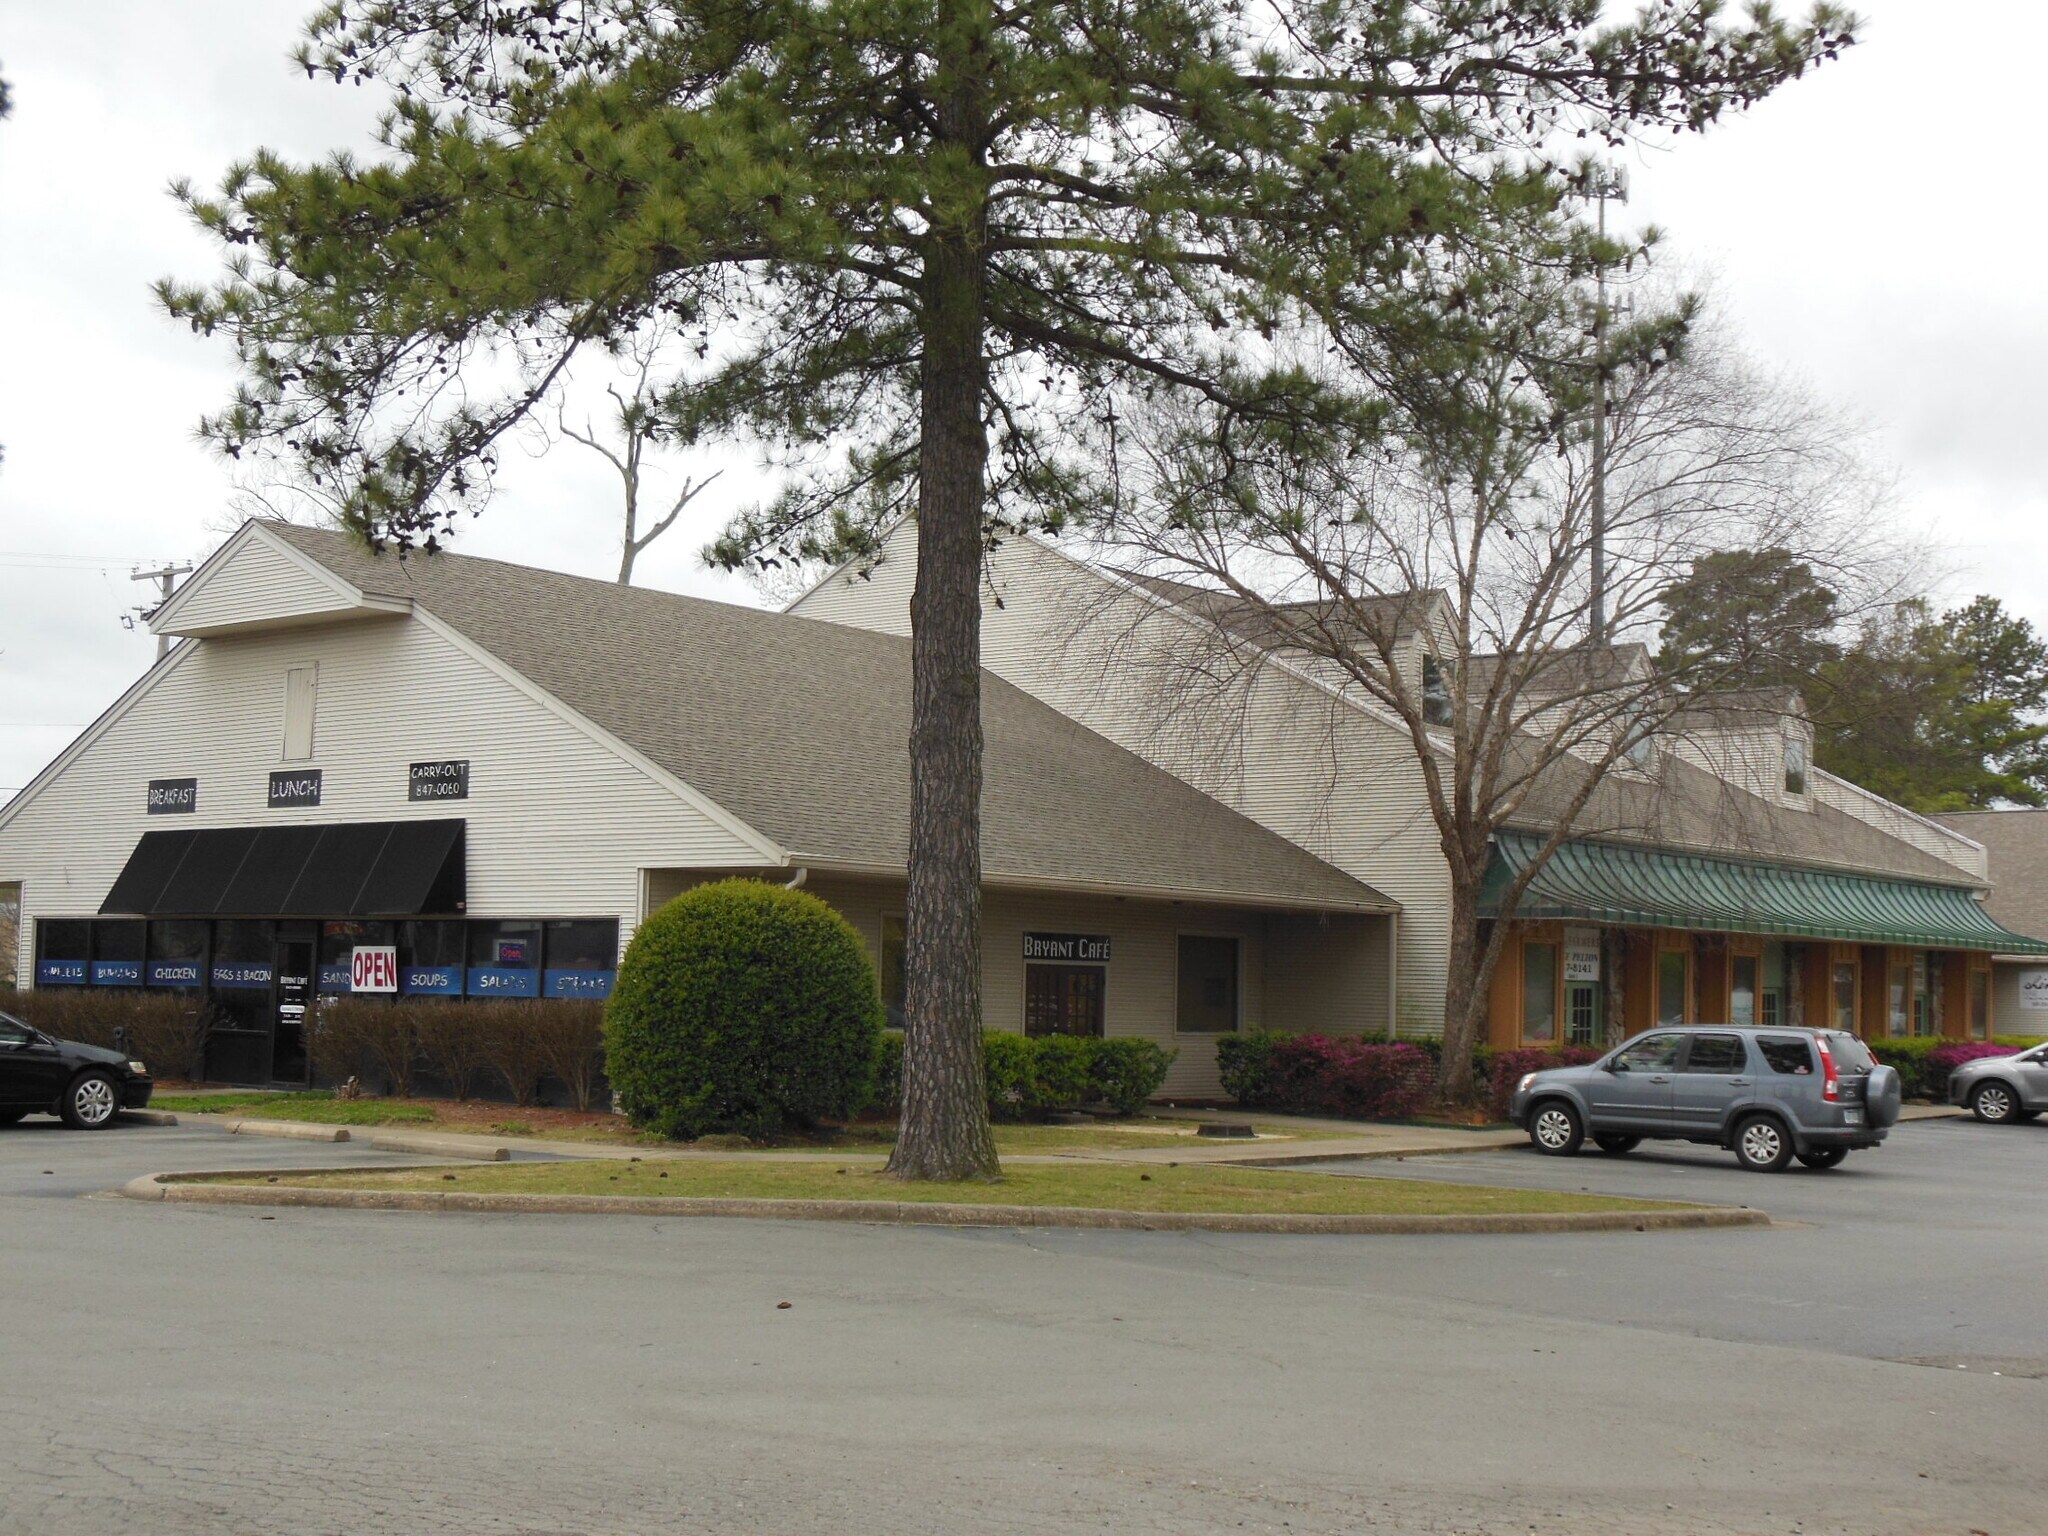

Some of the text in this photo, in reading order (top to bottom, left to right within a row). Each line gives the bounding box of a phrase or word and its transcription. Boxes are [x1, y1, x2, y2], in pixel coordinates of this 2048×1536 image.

[411, 763, 466, 779] CARRY-OUT
[149, 788, 195, 805] BREAKFAST
[271, 780, 318, 798] LUNCH
[154, 967, 197, 979] CHICKEN
[213, 968, 234, 980] EGGS
[243, 969, 272, 982] BACON
[353, 952, 395, 987] OPEN
[410, 974, 448, 987] SOUPS
[556, 976, 605, 991] SEAS
